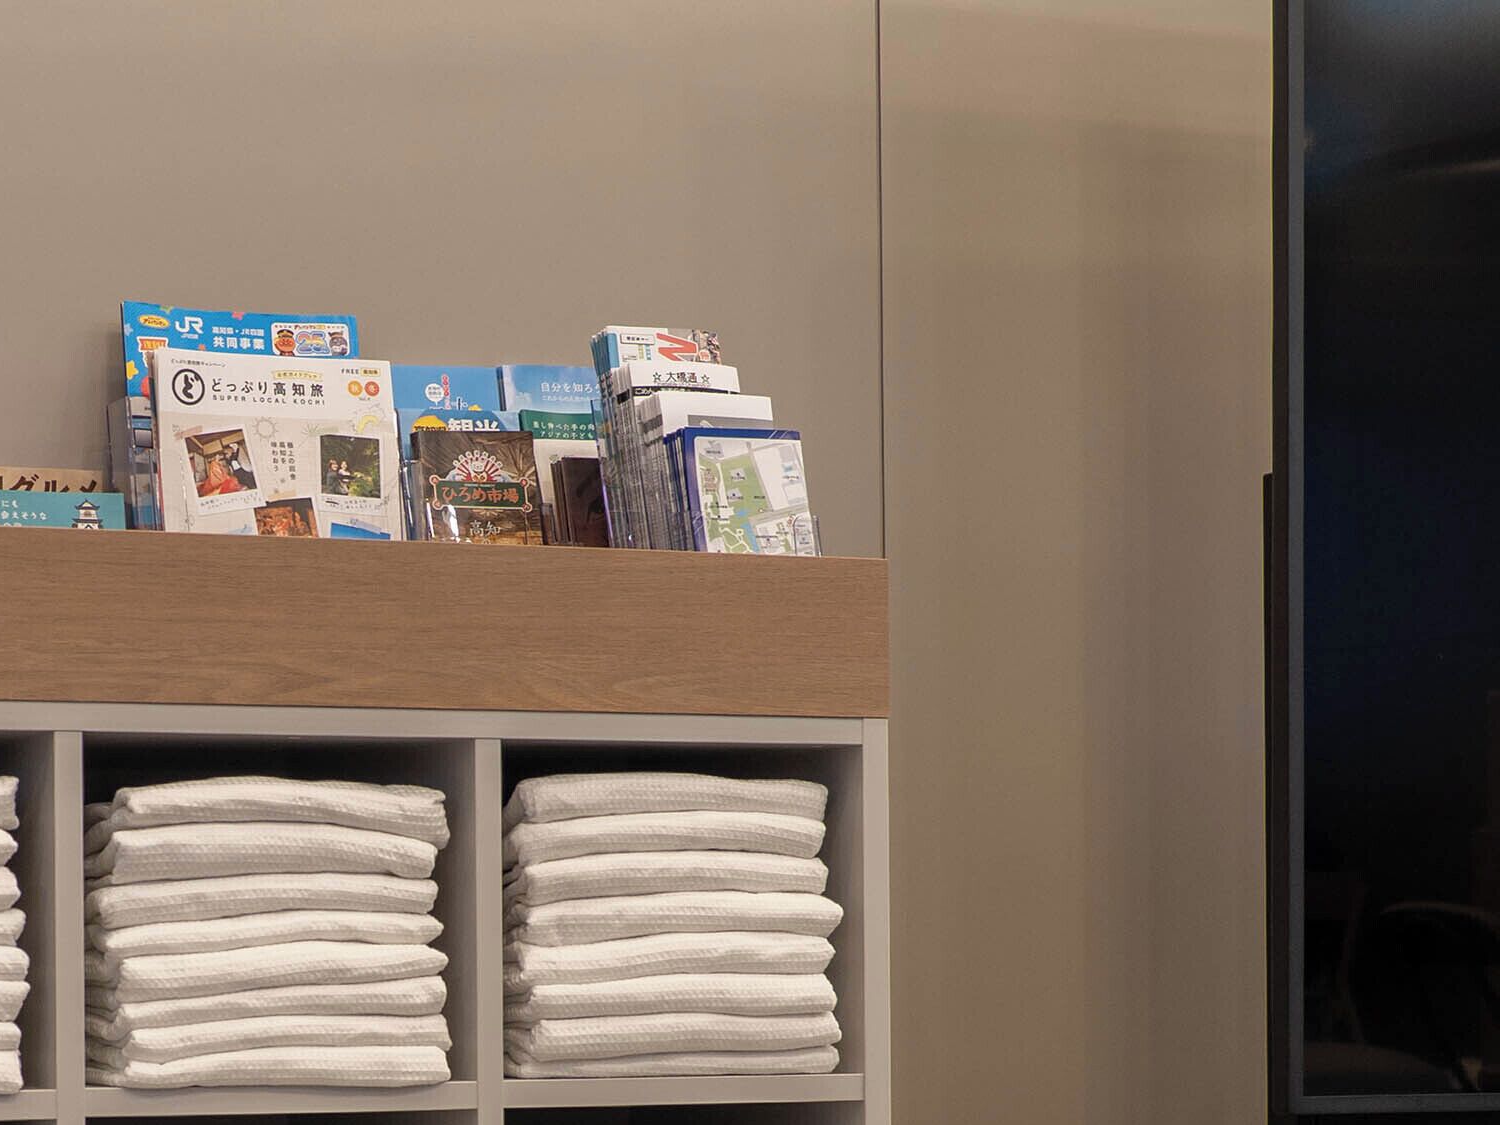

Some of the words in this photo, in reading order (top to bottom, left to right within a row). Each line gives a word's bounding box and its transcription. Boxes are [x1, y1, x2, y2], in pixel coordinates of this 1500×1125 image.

[175, 316, 204, 334] JR
[213, 336, 265, 350] 共同事業
[666, 371, 698, 384] 大橋通
[211, 378, 324, 397] どっぷり高知旅
[212, 394, 247, 402] SUPER
[253, 396, 287, 404] LOCAL
[293, 398, 325, 406] KOCHI
[442, 486, 519, 503] ひろめ市場
[470, 520, 501, 536] 高知
